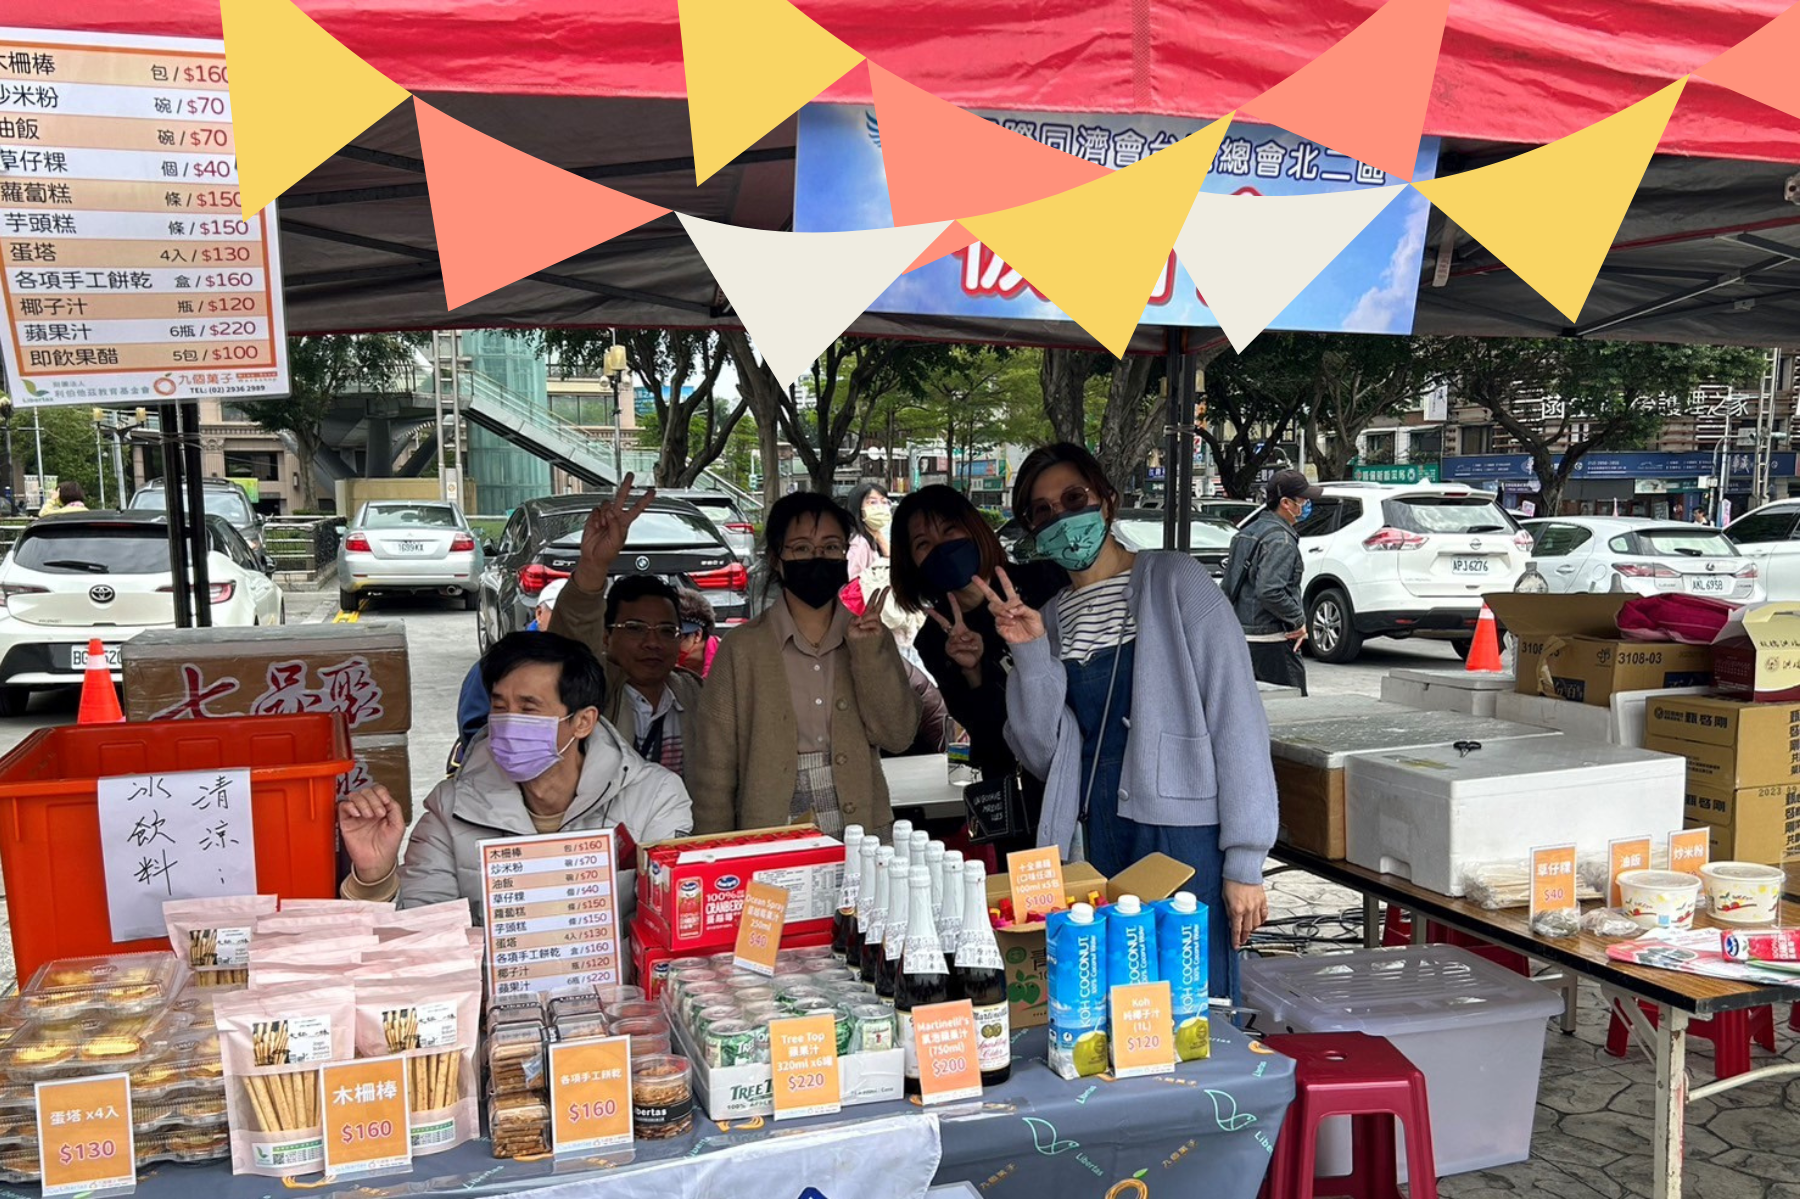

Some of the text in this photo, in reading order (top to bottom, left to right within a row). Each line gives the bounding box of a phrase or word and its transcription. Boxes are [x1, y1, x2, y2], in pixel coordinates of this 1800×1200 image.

[151, 64, 169, 82] 包
[155, 97, 172, 114] 碗
[187, 97, 225, 115] $70
[158, 129, 175, 146] 碗
[190, 129, 228, 147] $70
[162, 161, 178, 177] 個
[194, 160, 230, 178] $40
[1, 181, 73, 204] 蘿蔔糕
[165, 191, 182, 207] 條
[4, 212, 77, 234] 芋頭糕
[168, 221, 185, 236] 條
[200, 219, 249, 235] $150
[10, 242, 57, 262] 蛋塔
[160, 249, 187, 263] 4入
[202, 246, 250, 262] $130
[15, 270, 152, 290] 各項手工餅乾
[175, 275, 191, 288] 盒
[205, 272, 253, 288] $160
[20, 298, 88, 316] 椰子汁
[178, 301, 194, 314] 瓶
[208, 297, 255, 313] $120
[25, 323, 92, 341] 蘋果汁
[170, 325, 195, 338] 6瓶
[209, 321, 256, 337] $220
[30, 348, 118, 367] 即飲果醋
[172, 349, 198, 362] 5包
[212, 345, 258, 361] $100
[209, 386, 225, 395] (02)
[1618, 651, 1662, 665] 3108-03
[1758, 787, 1782, 797] 2023
[127, 776, 178, 896] 冰飲料
[490, 847, 522, 859] 木柵棒
[579, 840, 602, 851] $160
[1673, 845, 1704, 860] 炒米粉
[491, 862, 523, 875] 炒米粉
[580, 855, 597, 866] $70
[1536, 861, 1572, 876] 草仔粿
[1619, 855, 1641, 868] 油飯
[581, 870, 598, 880] $70
[581, 884, 599, 895] $40
[706, 890, 738, 902] 100%
[1544, 889, 1564, 902] $40
[582, 898, 606, 909] $150
[1025, 893, 1055, 909] $100
[583, 913, 607, 924] $150
[584, 927, 608, 938] $130
[748, 930, 767, 948] $40
[585, 942, 609, 953] $160
[586, 957, 610, 968] $120
[587, 971, 610, 983] $220
[1131, 997, 1151, 1008] Koh
[917, 1016, 970, 1031] Martinelli's
[781, 1032, 825, 1044] Tree Top
[1128, 1035, 1159, 1051] $120
[929, 1041, 965, 1057] (750ml)
[777, 1059, 808, 1071] 320ml
[932, 1058, 967, 1076] $200
[788, 1073, 825, 1091] $220
[333, 1080, 398, 1106] 木柵棒
[50, 1105, 120, 1126] 蛋塔 x4入
[568, 1099, 617, 1124] $160
[341, 1120, 393, 1145] $160
[60, 1140, 117, 1165] $130
[1075, 1152, 1104, 1177] Libertas
